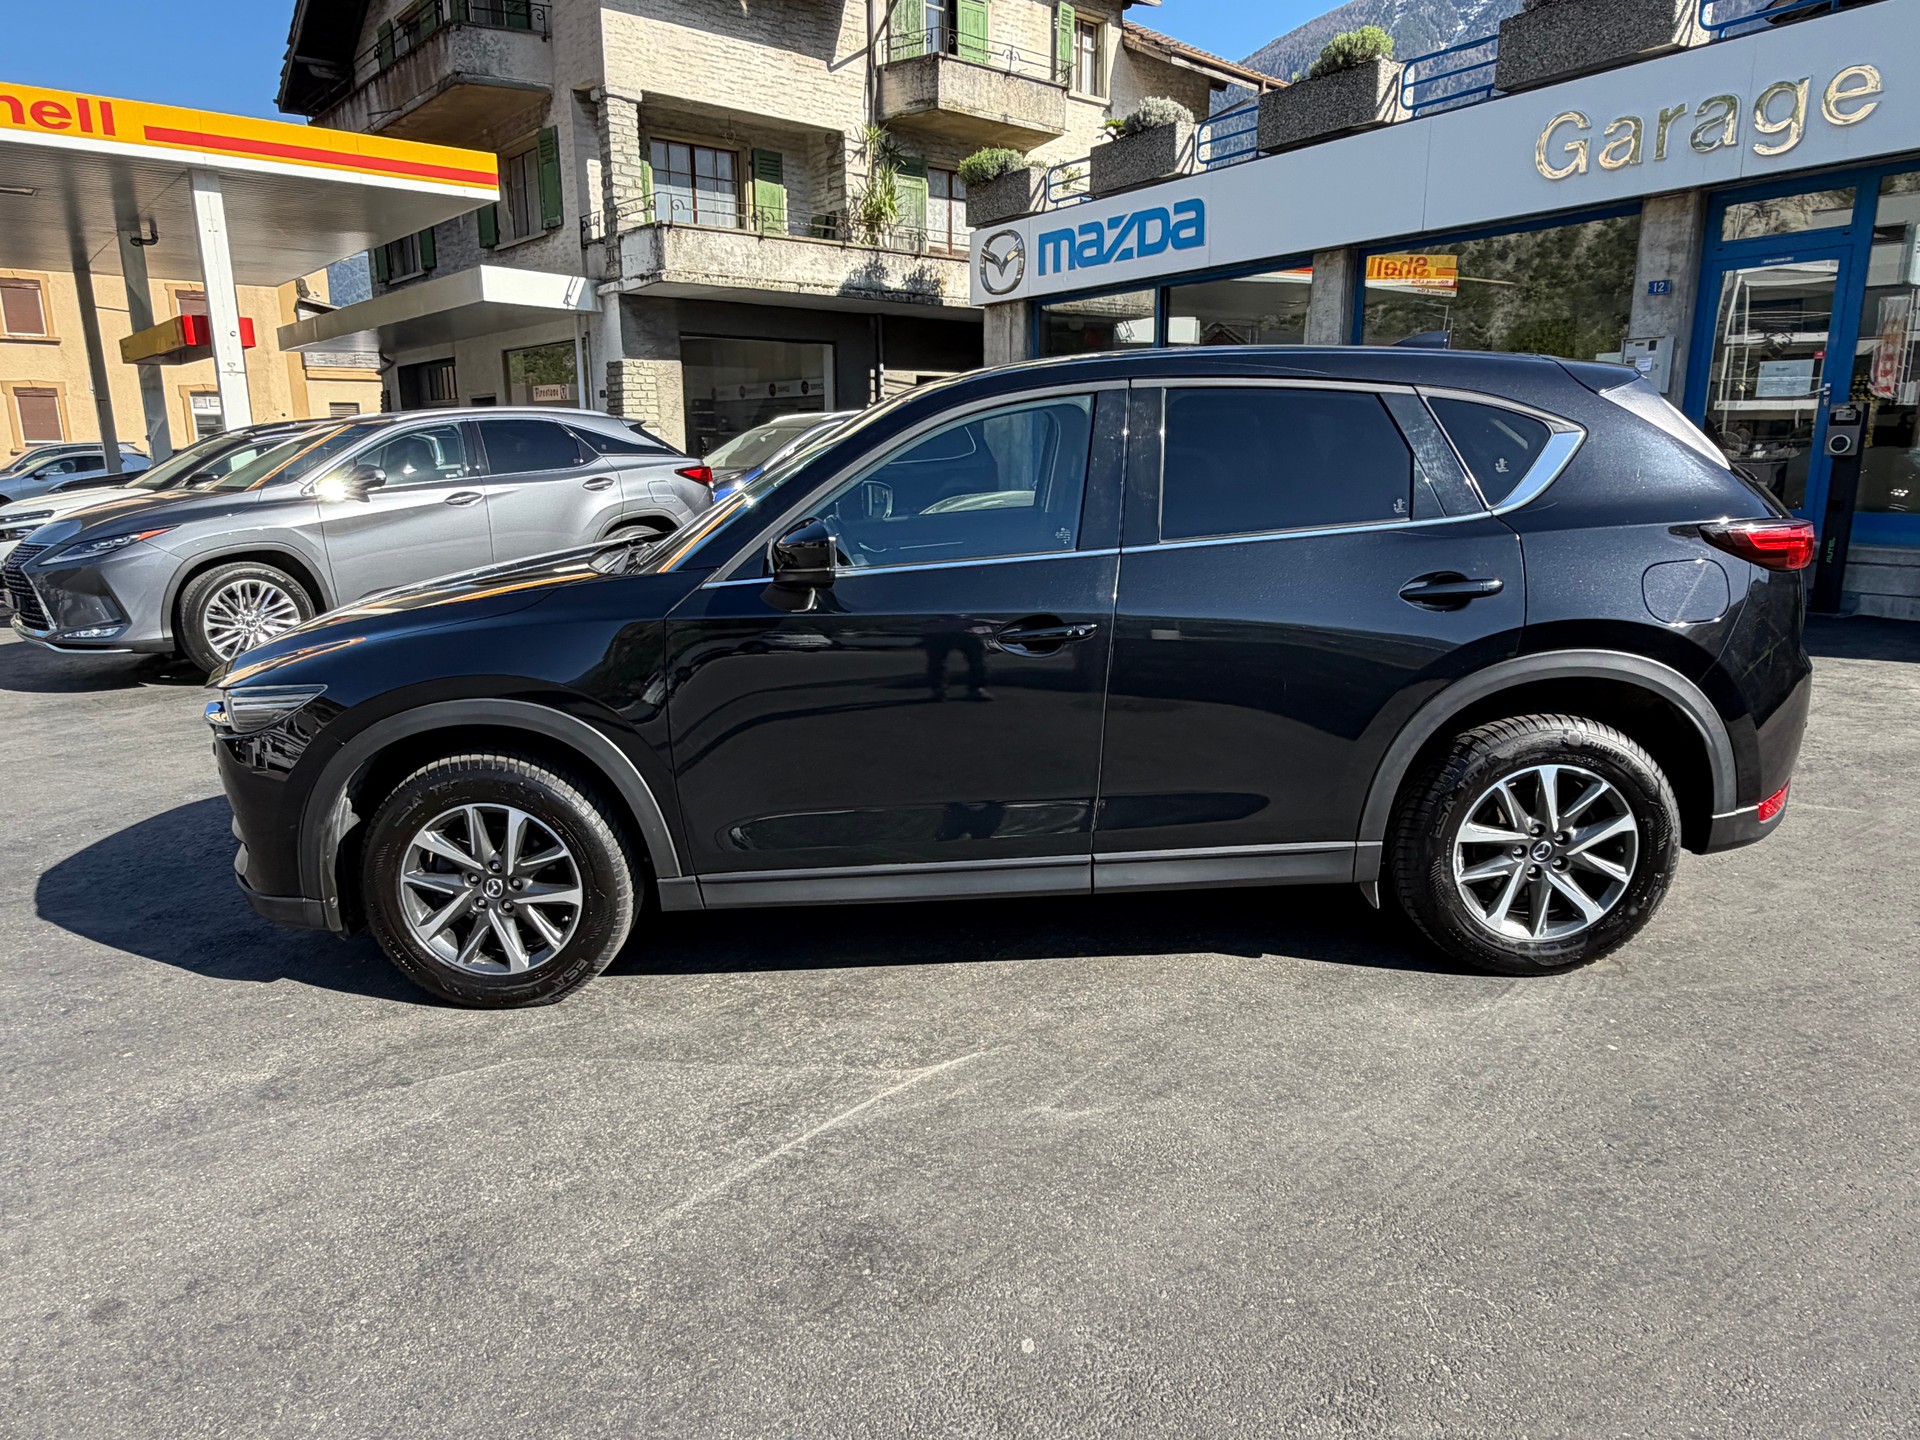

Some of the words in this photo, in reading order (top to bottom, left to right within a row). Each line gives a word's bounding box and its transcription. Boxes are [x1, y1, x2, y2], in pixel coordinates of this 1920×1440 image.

[1535, 64, 1884, 180] Garage
[1653, 281, 1665, 292] 12
[1826, 537, 1836, 564] AUTEL
